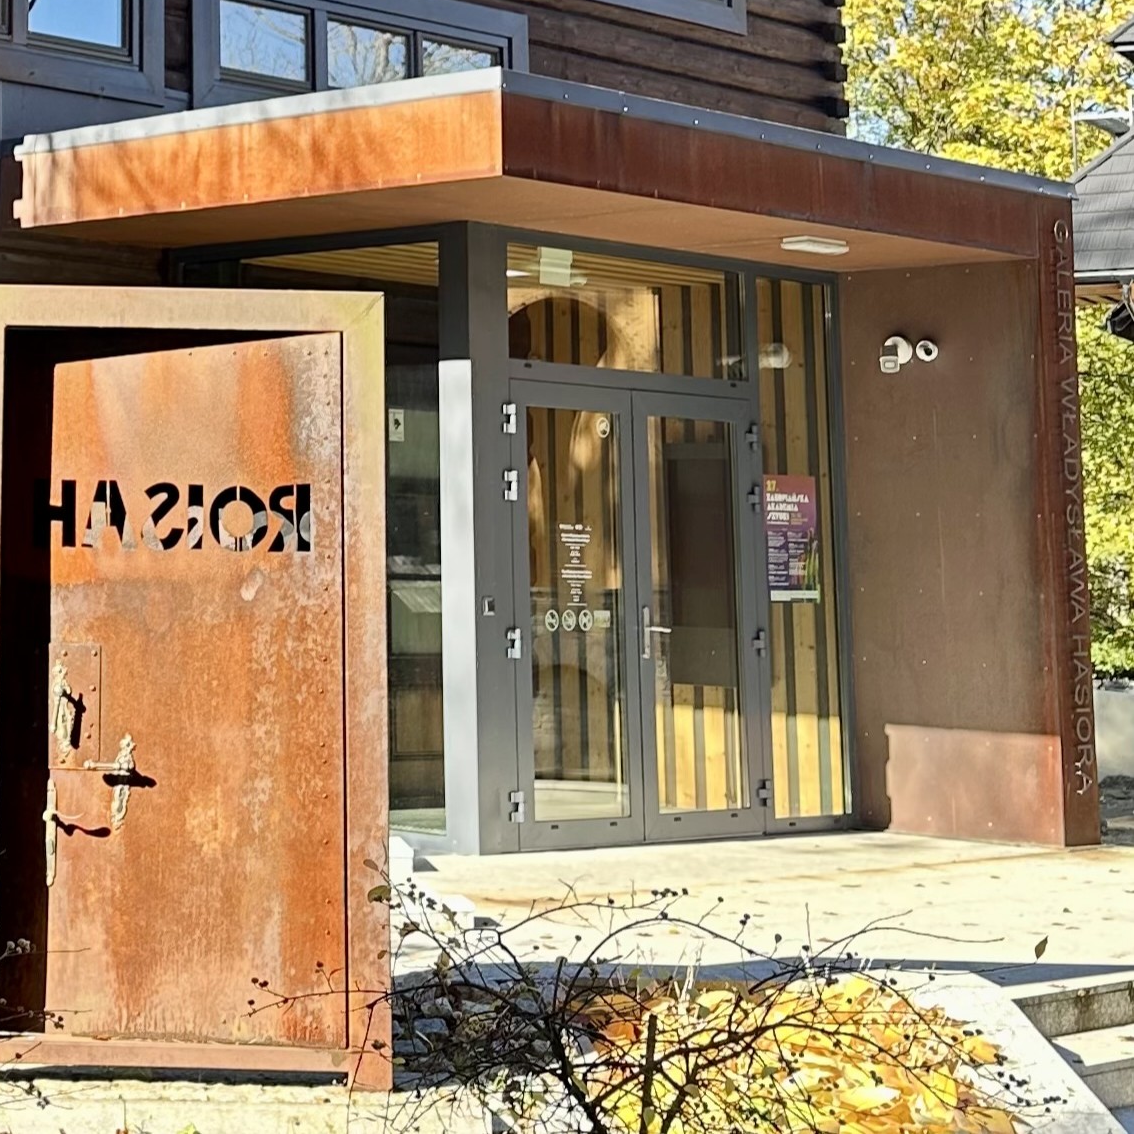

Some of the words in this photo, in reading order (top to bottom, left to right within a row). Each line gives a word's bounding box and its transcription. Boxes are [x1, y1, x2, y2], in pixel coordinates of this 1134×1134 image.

[1053, 219, 1073, 364] GALERIA
[1060, 376, 1086, 624] WŁADYSŁAWA
[1071, 634, 1094, 795] HASIORA
